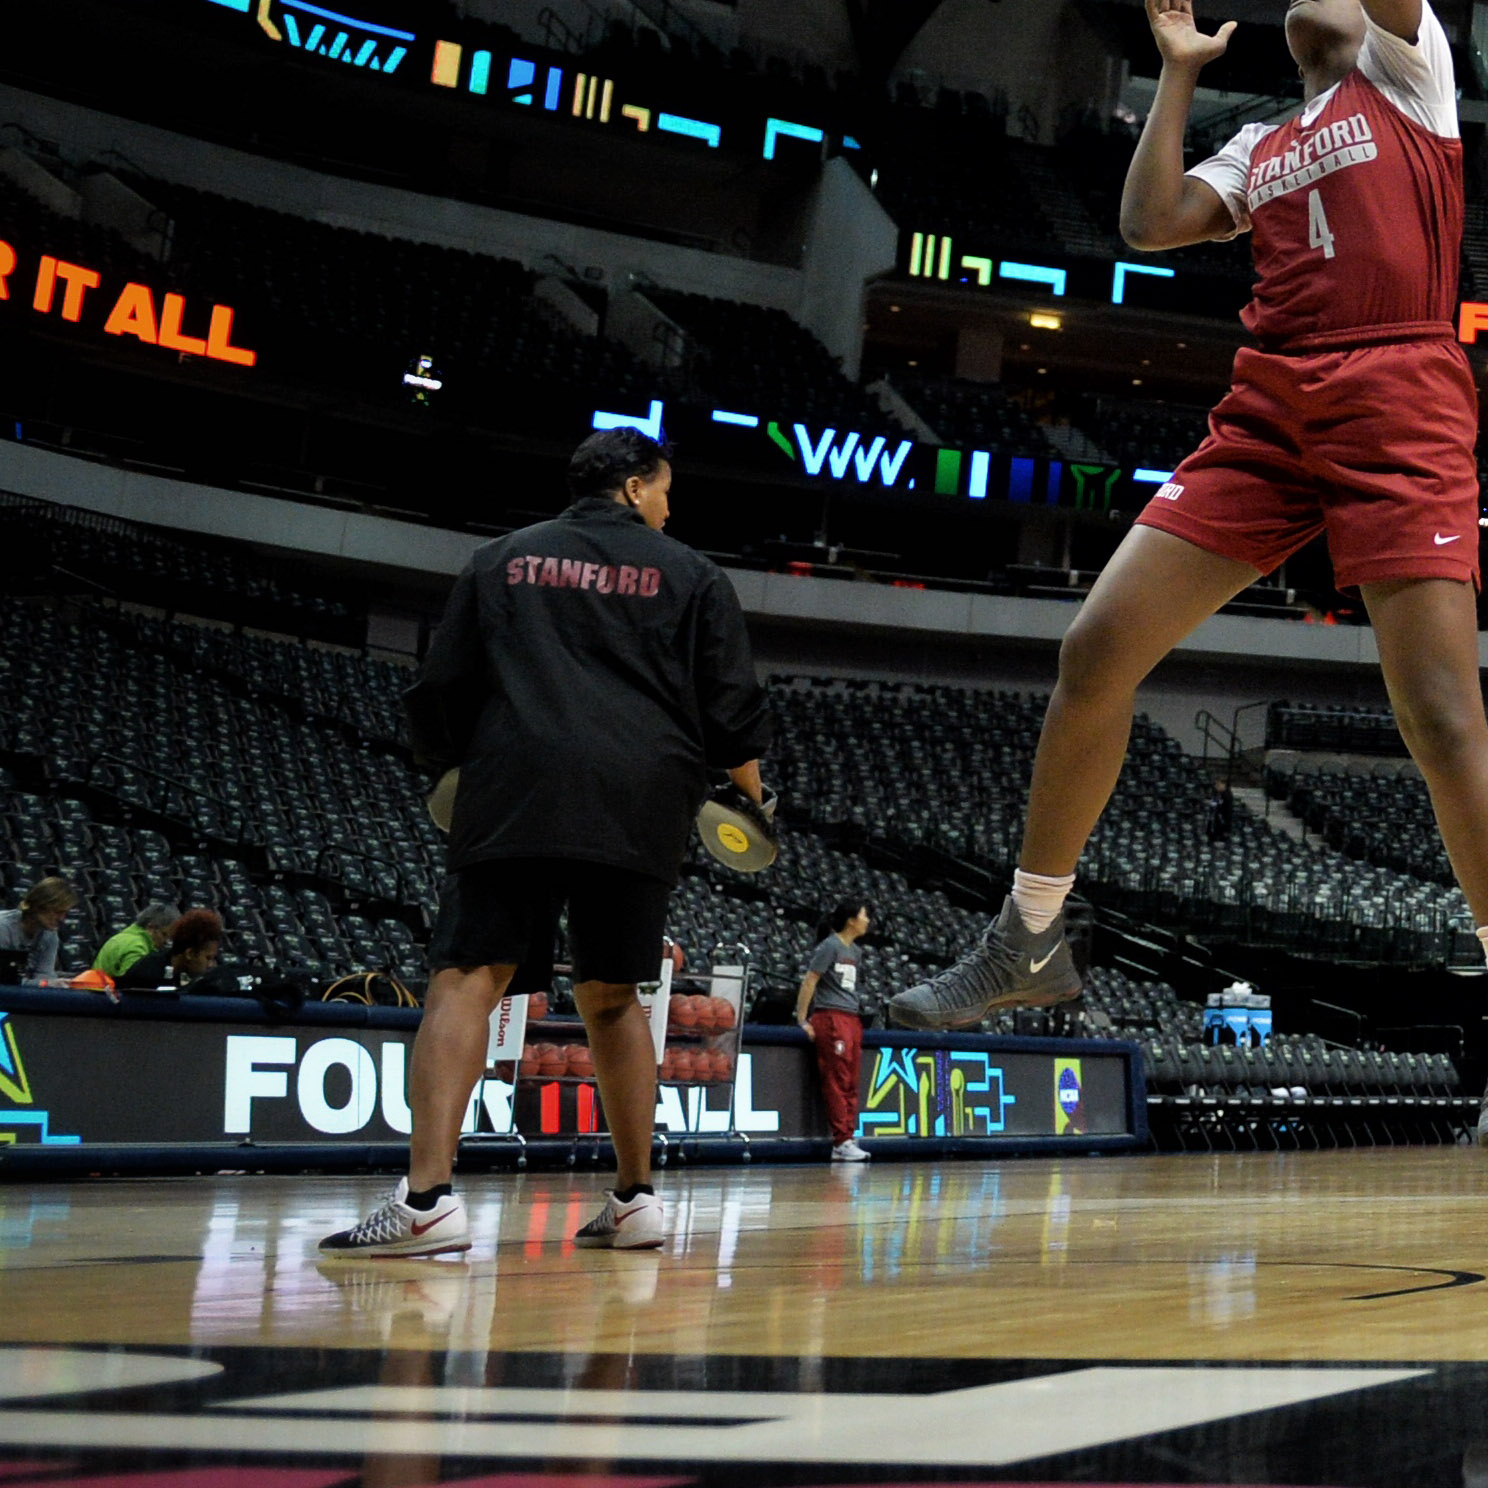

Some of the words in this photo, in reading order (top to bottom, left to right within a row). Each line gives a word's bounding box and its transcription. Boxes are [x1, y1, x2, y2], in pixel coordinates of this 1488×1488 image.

[1308, 188, 1335, 260] 4
[33, 255, 101, 323] IT
[104, 281, 257, 367] ALL
[507, 554, 662, 597] STANFORD
